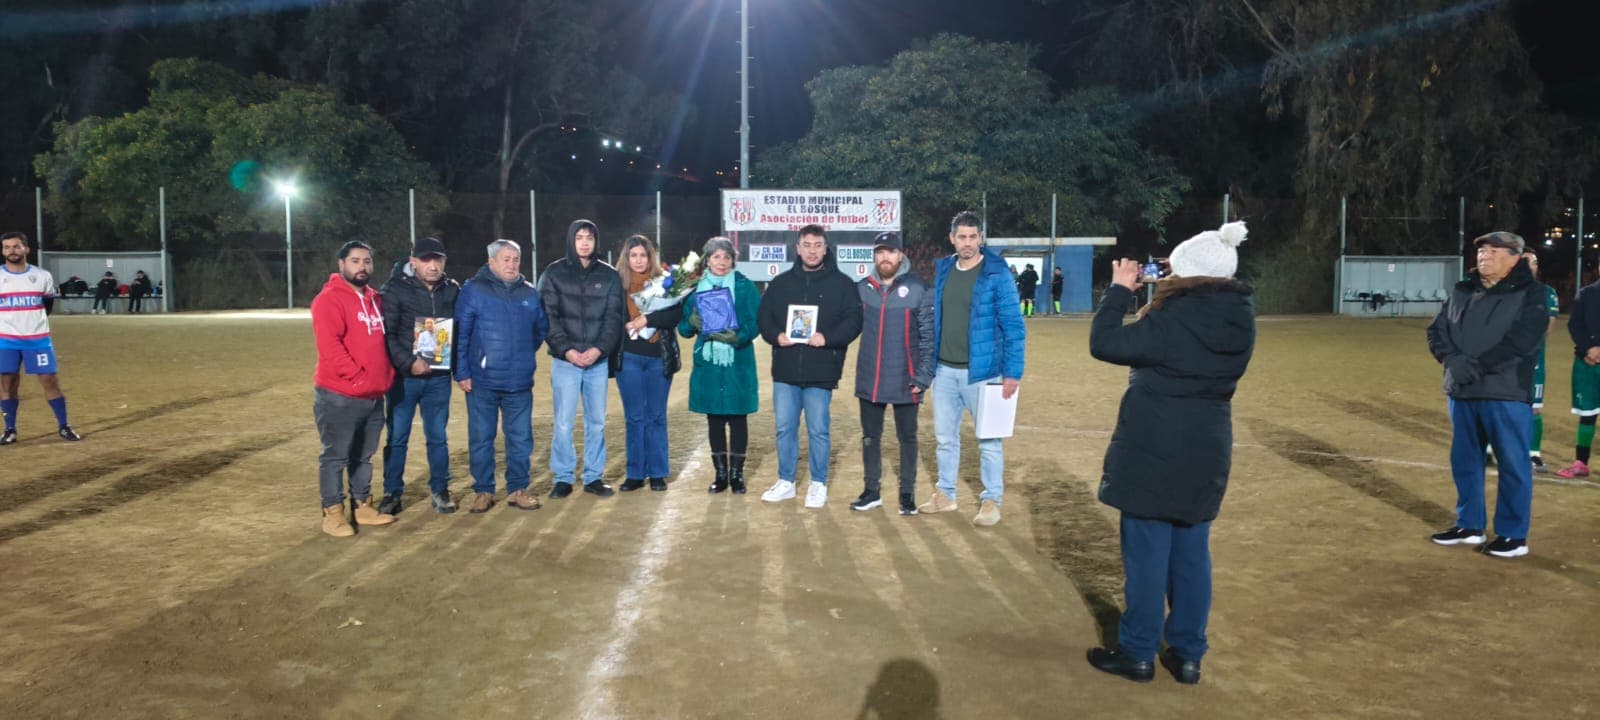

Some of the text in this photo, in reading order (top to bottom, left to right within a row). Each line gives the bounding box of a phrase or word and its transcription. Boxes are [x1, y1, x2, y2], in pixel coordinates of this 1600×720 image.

[764, 196, 863, 205] ESTADIO MUNICIPAL
[787, 205, 840, 214] EL BOSQUE
[822, 214, 834, 224] de
[761, 252, 784, 260] ANTONIO
[846, 248, 872, 260] EL BOSQUE
[770, 266, 776, 275] 0
[858, 264, 865, 274] 0
[36, 354, 48, 366] 13
